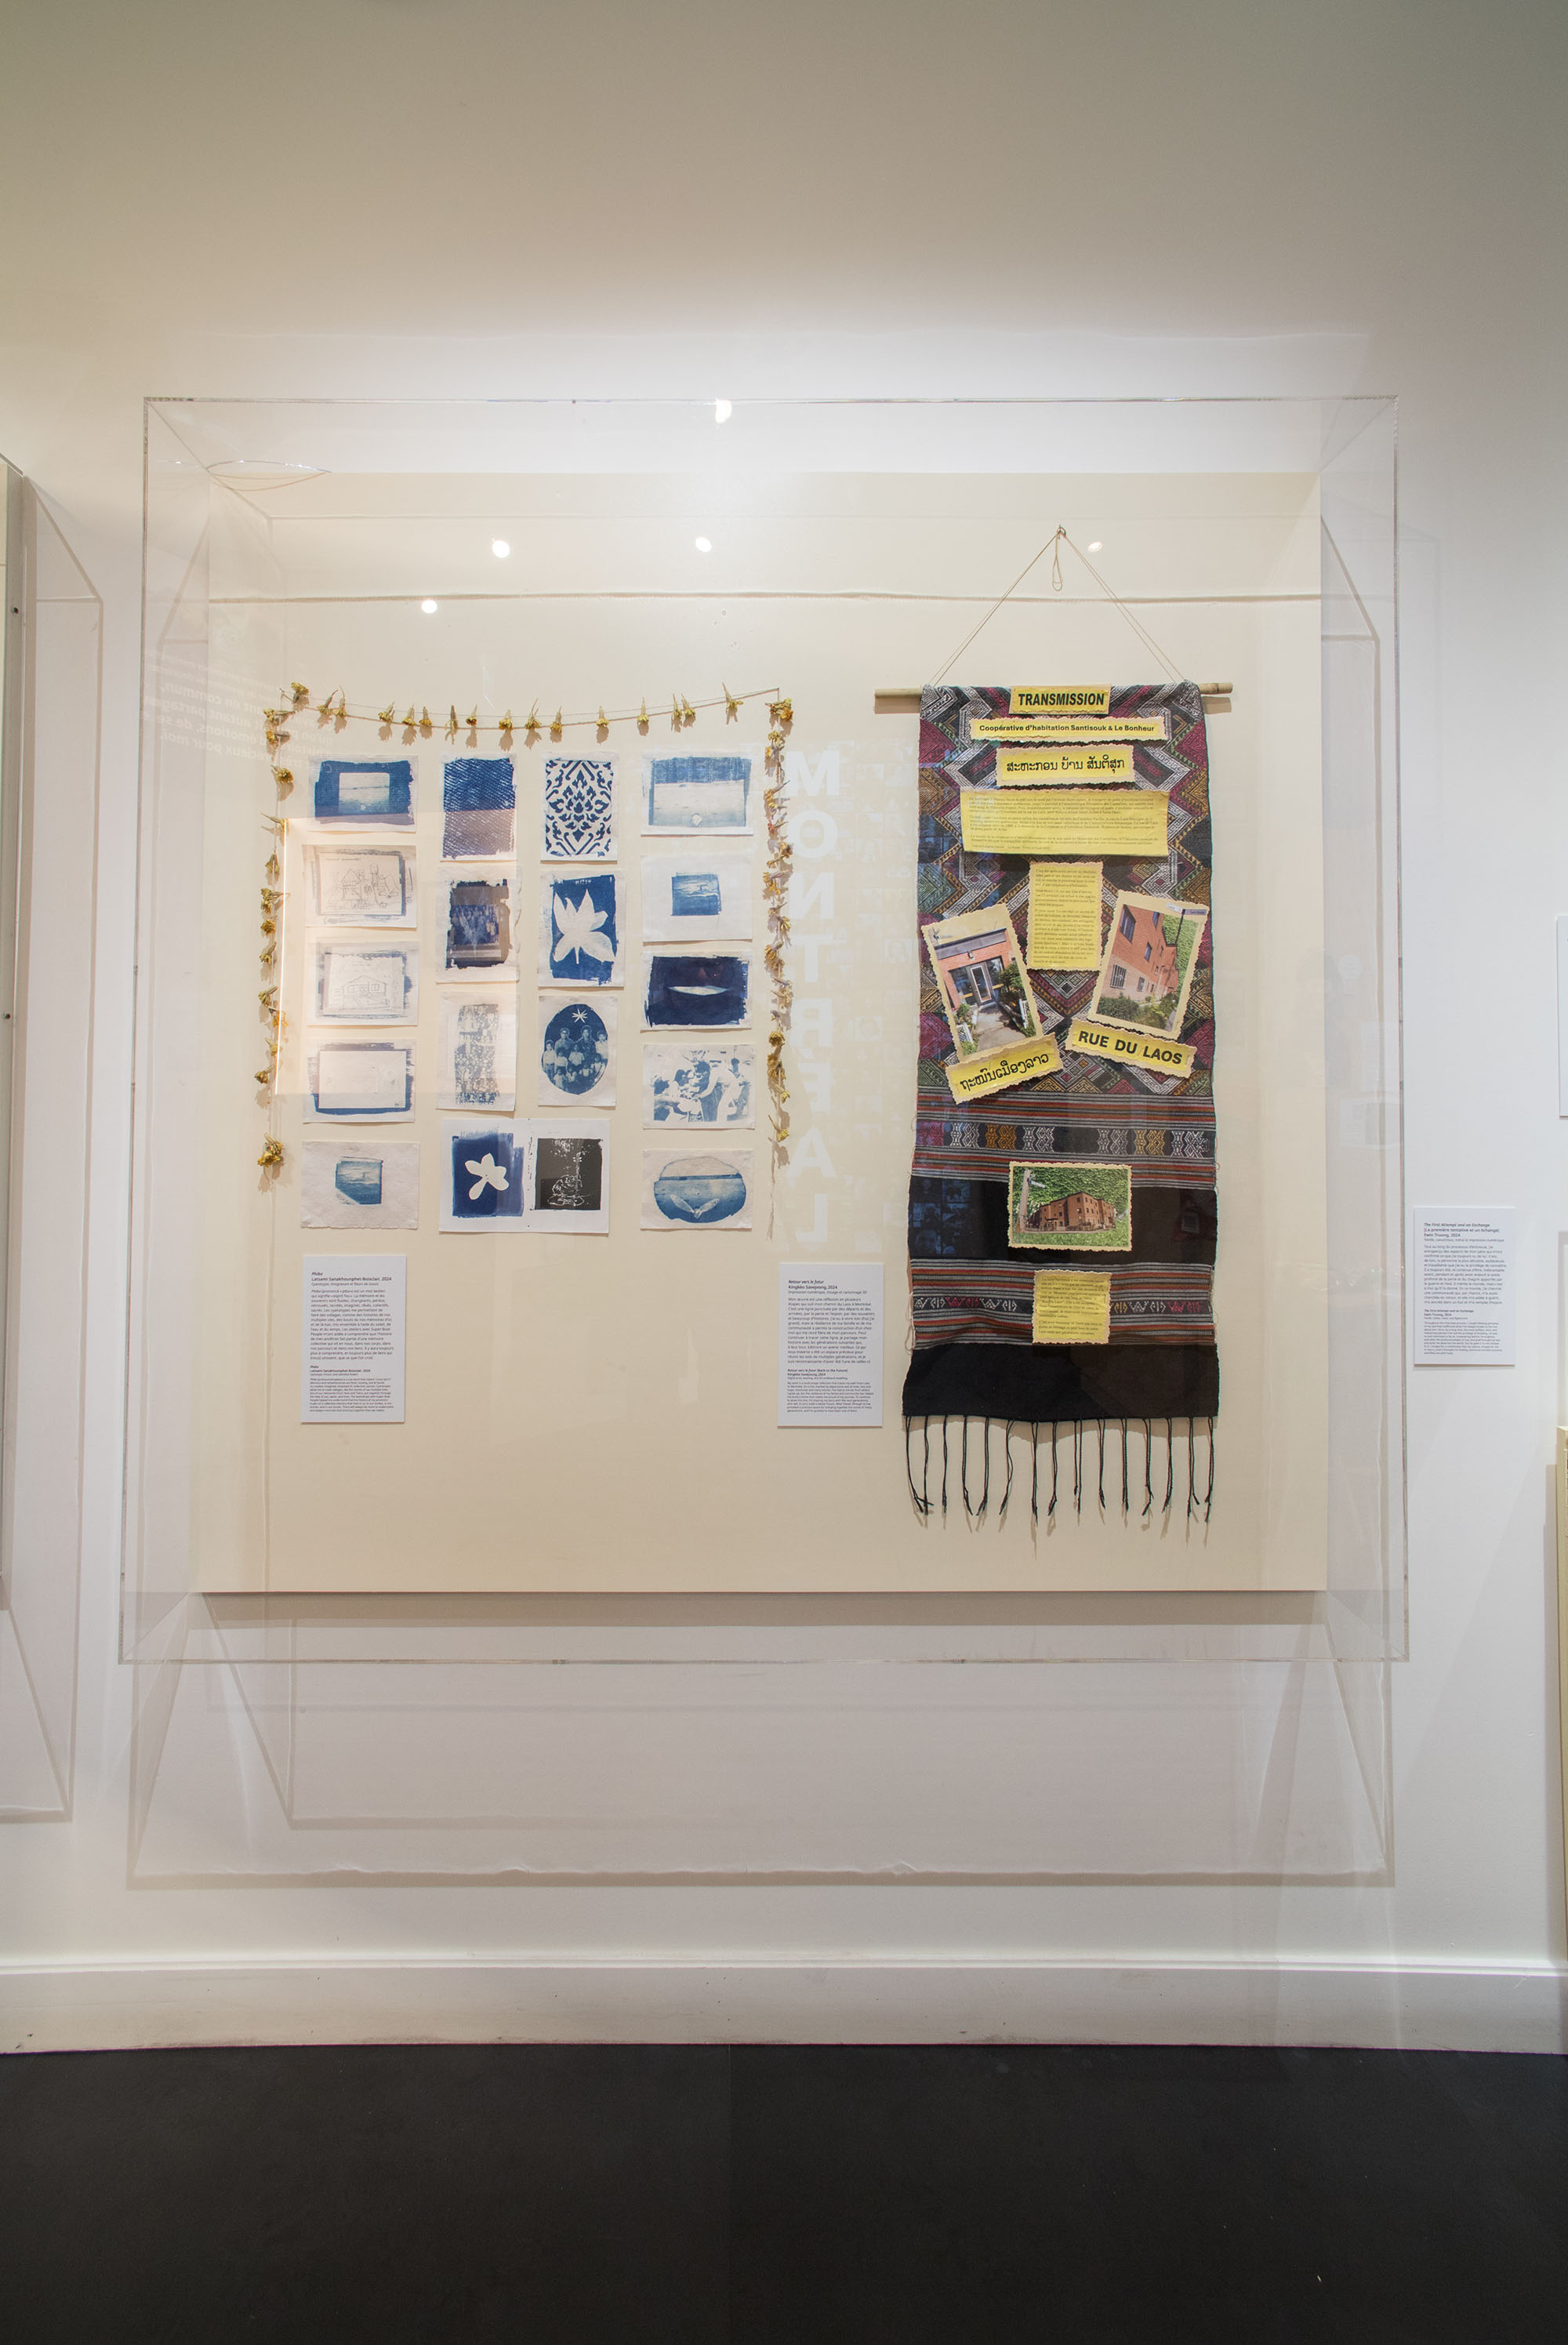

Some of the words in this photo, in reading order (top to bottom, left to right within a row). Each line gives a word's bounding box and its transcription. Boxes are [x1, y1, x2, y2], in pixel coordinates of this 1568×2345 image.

[1018, 693, 1105, 706] TRANSMISSION
[1078, 1031, 1108, 1048] RUE
[1114, 1040, 1138, 1055] DU
[1143, 1046, 1183, 1065] LAOS
